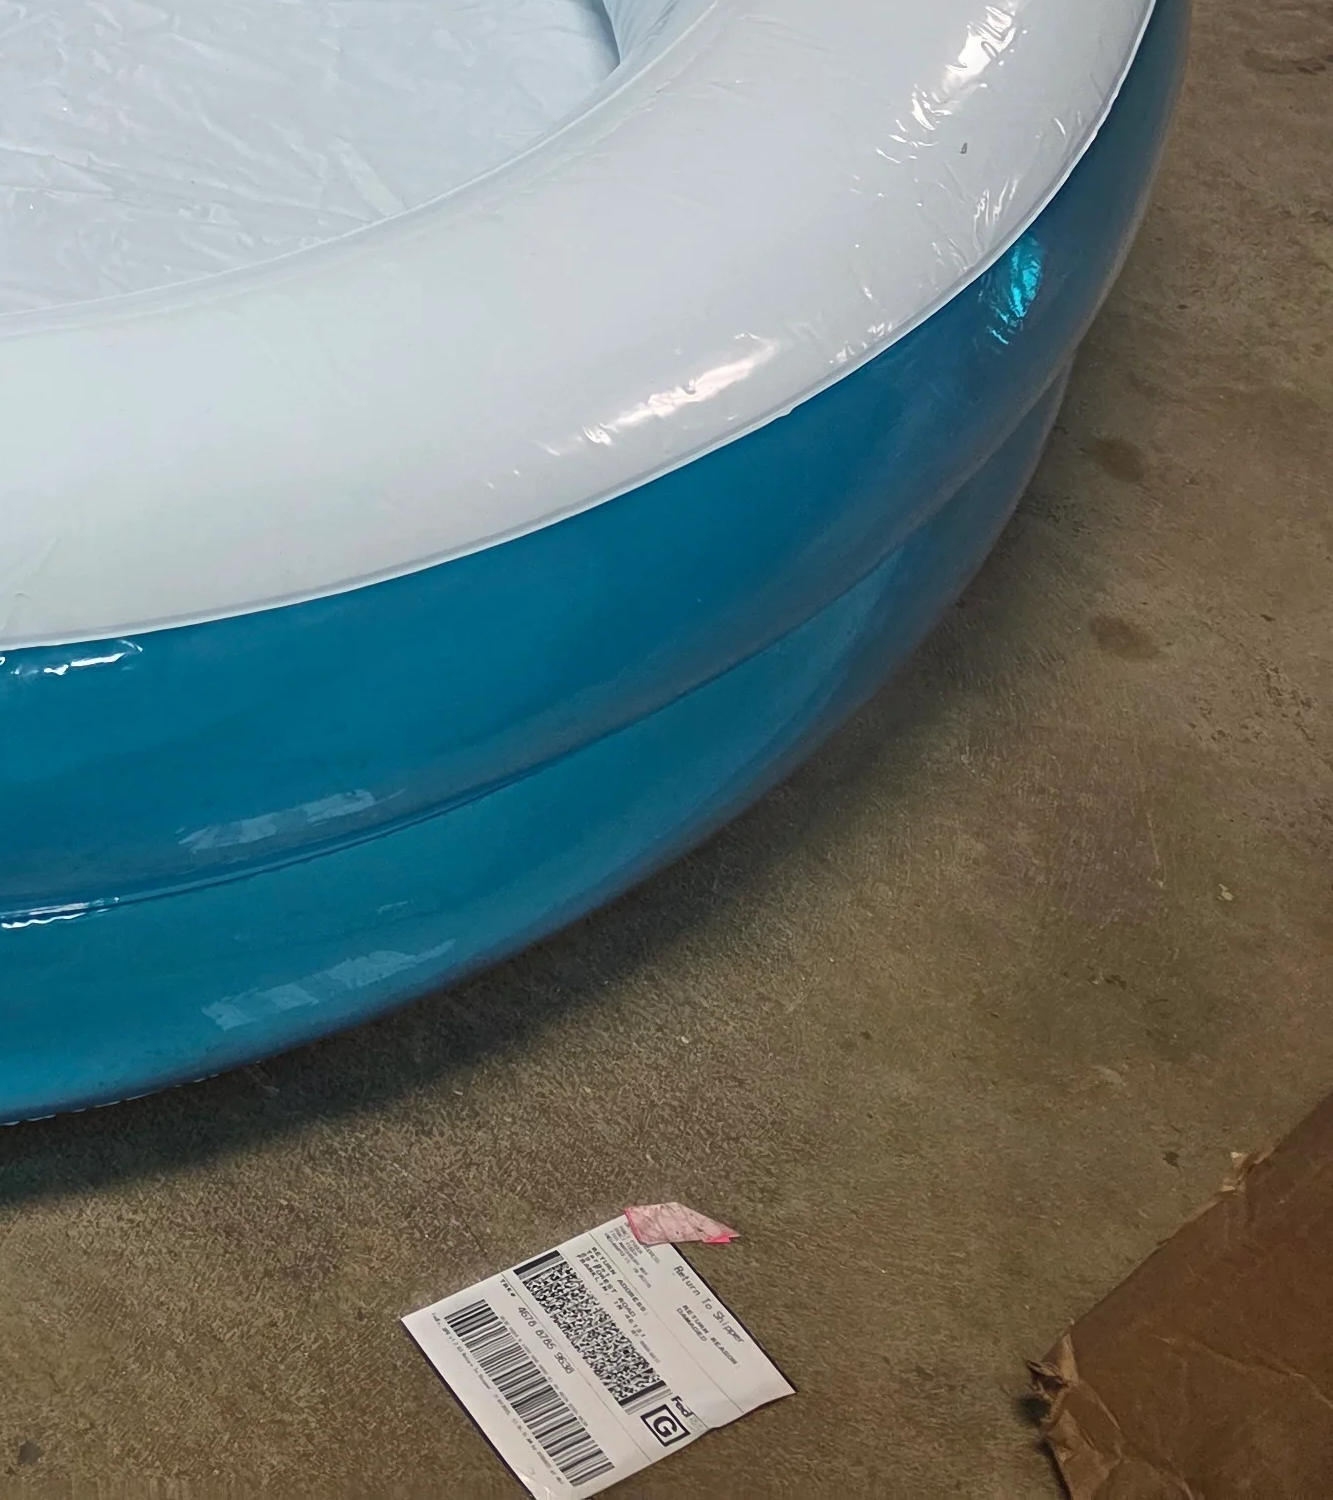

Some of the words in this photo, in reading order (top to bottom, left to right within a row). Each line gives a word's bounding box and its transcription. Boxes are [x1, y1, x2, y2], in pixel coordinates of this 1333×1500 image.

[591, 1245, 616, 1275] RETURN
[617, 1296, 636, 1317] ROAD
[672, 1263, 703, 1297] Return
[701, 1296, 714, 1310] To
[709, 1309, 745, 1348] Shipper
[682, 1303, 709, 1334] RETURN
[676, 1306, 707, 1343] DAMAGED
[650, 1410, 680, 1441] G
